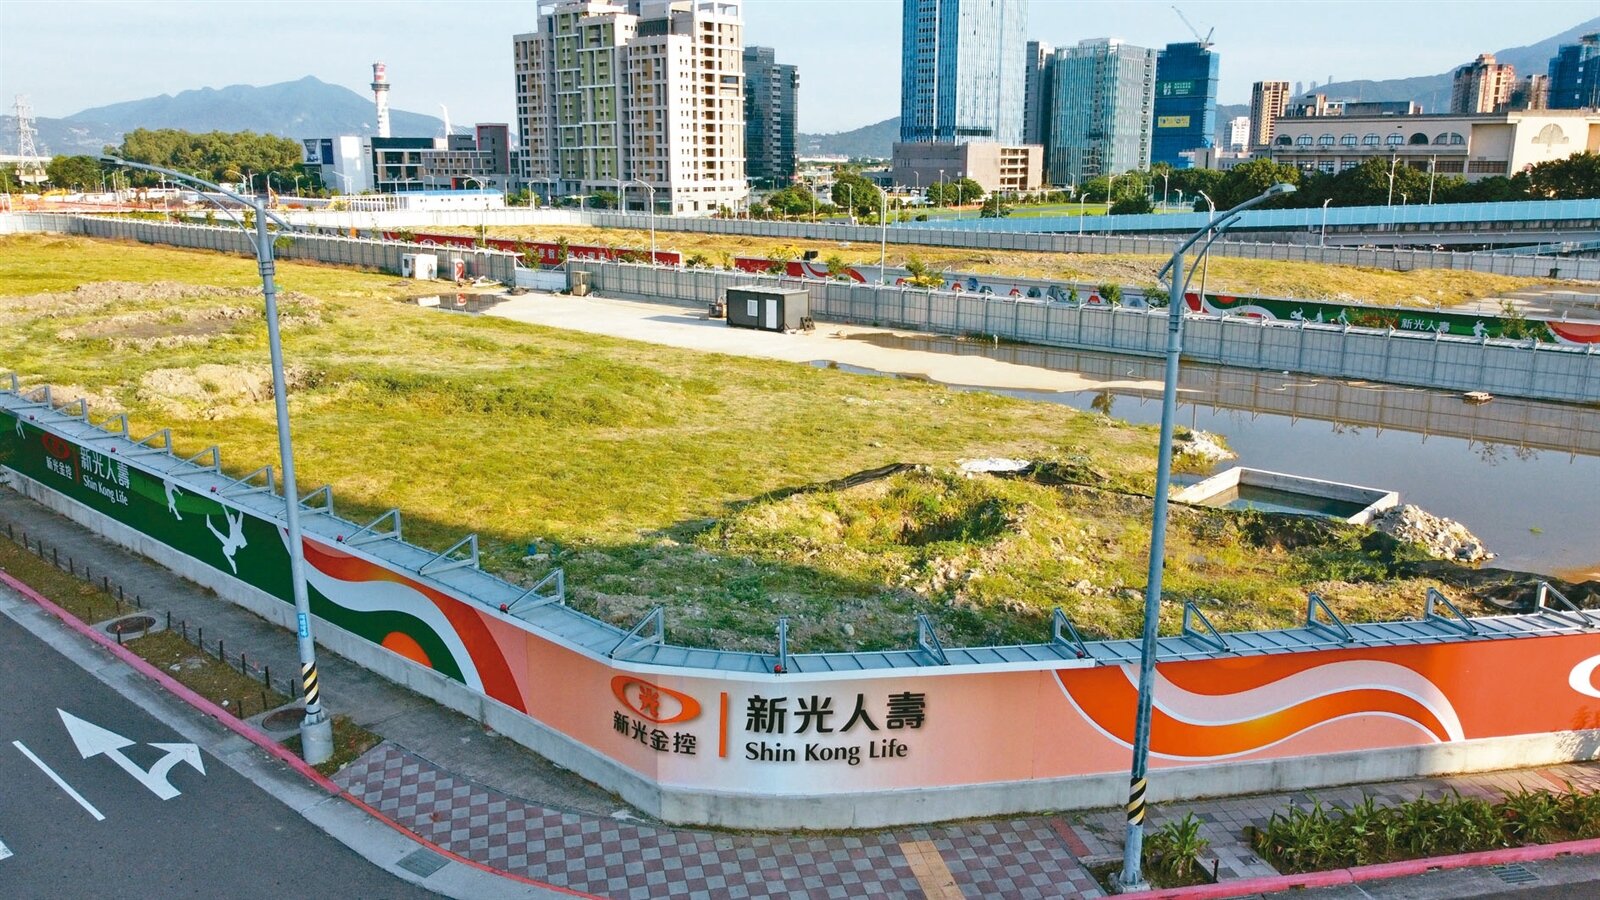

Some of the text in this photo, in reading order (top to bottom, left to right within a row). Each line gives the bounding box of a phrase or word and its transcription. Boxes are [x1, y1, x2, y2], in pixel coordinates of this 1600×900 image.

[1400, 318, 1450, 333] 新光人壽
[45, 456, 73, 480] 新光金控
[80, 447, 130, 489] 新光人壽
[82, 474, 128, 506] Shin Kong Life
[744, 691, 926, 734] 新光人壽
[613, 710, 697, 755] 新光金控
[745, 739, 908, 766] Shin Kong Life
